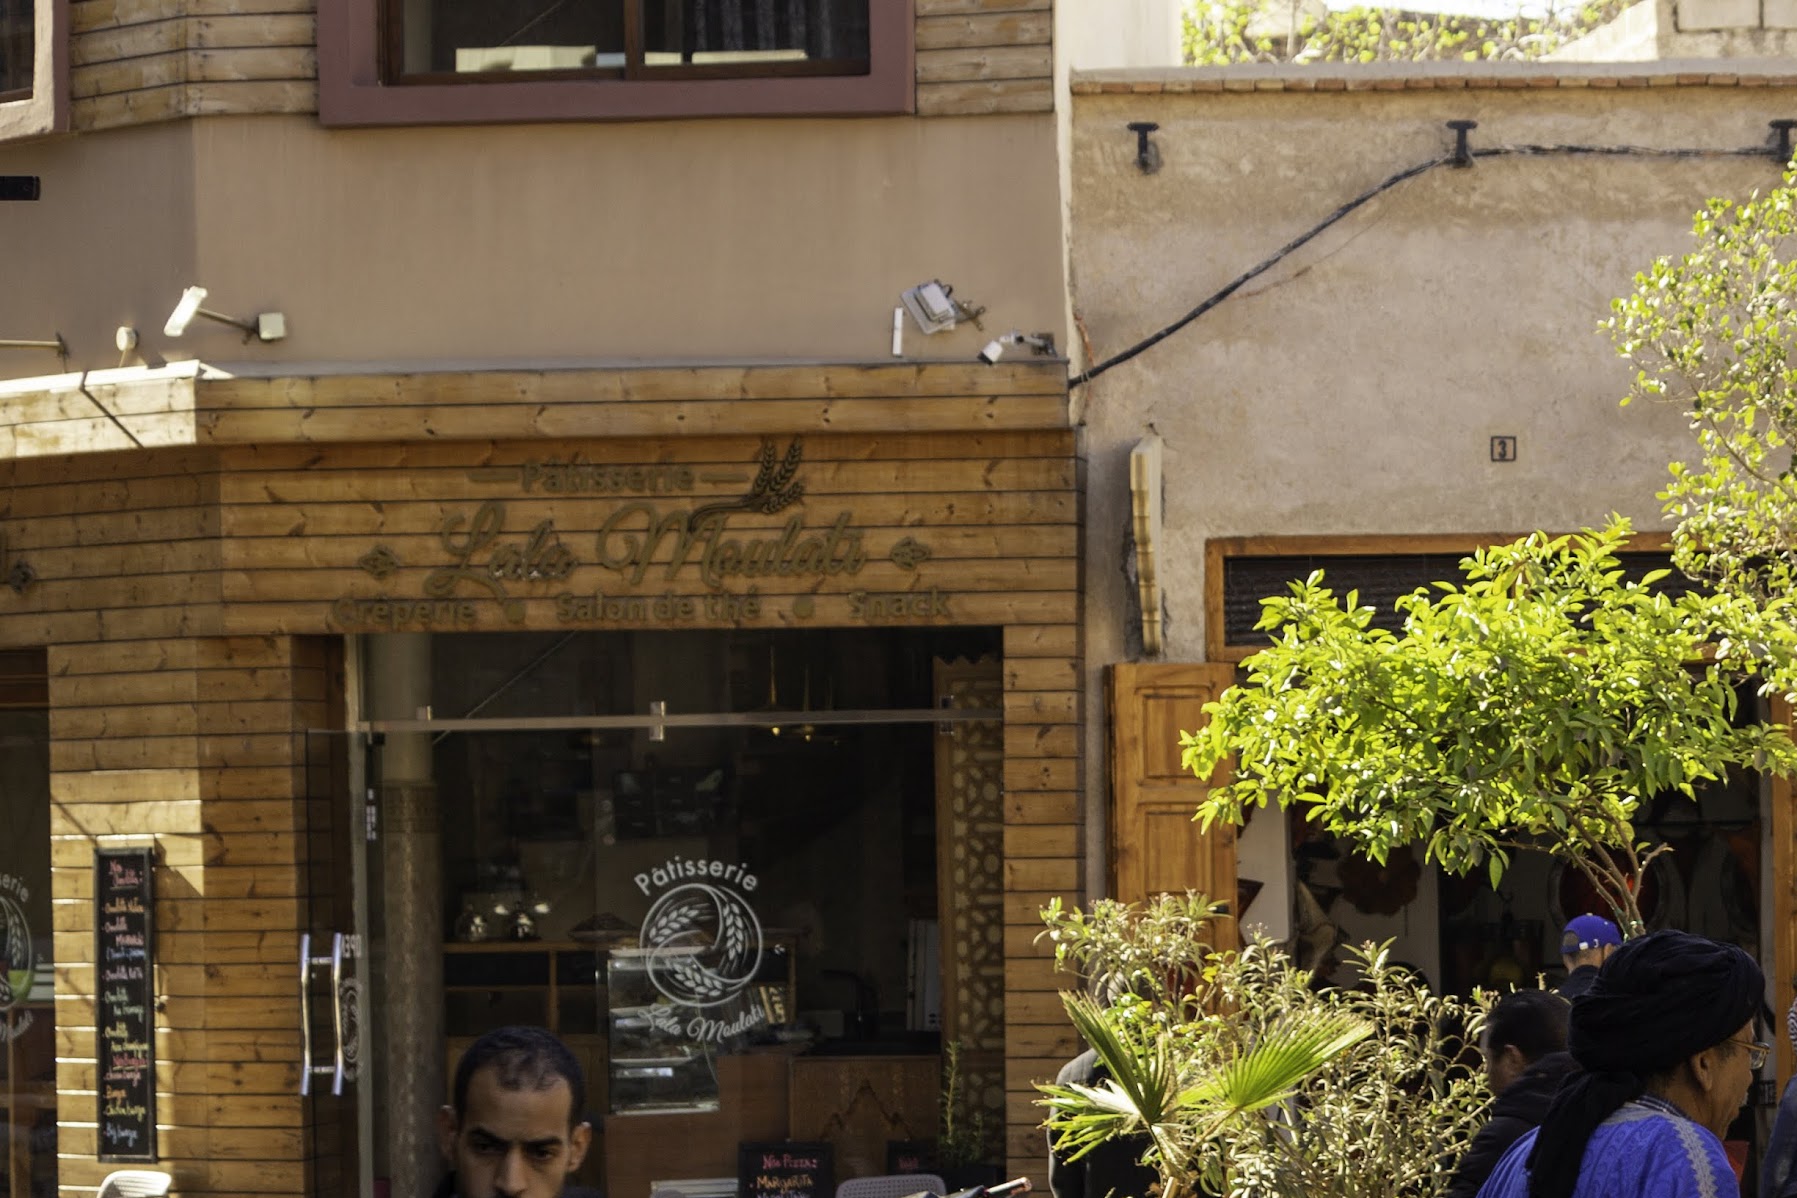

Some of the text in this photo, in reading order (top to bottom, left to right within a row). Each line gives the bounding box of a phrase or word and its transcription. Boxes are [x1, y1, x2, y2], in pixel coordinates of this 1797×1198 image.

[1498, 440, 1506, 459] 3
[423, 501, 580, 601] Lala
[334, 585, 951, 628] Crêperie Salon de thé Snack
[634, 855, 758, 896] Pâtisserie
[638, 1003, 682, 1036] Lala
[686, 1003, 765, 1044] Moulati
